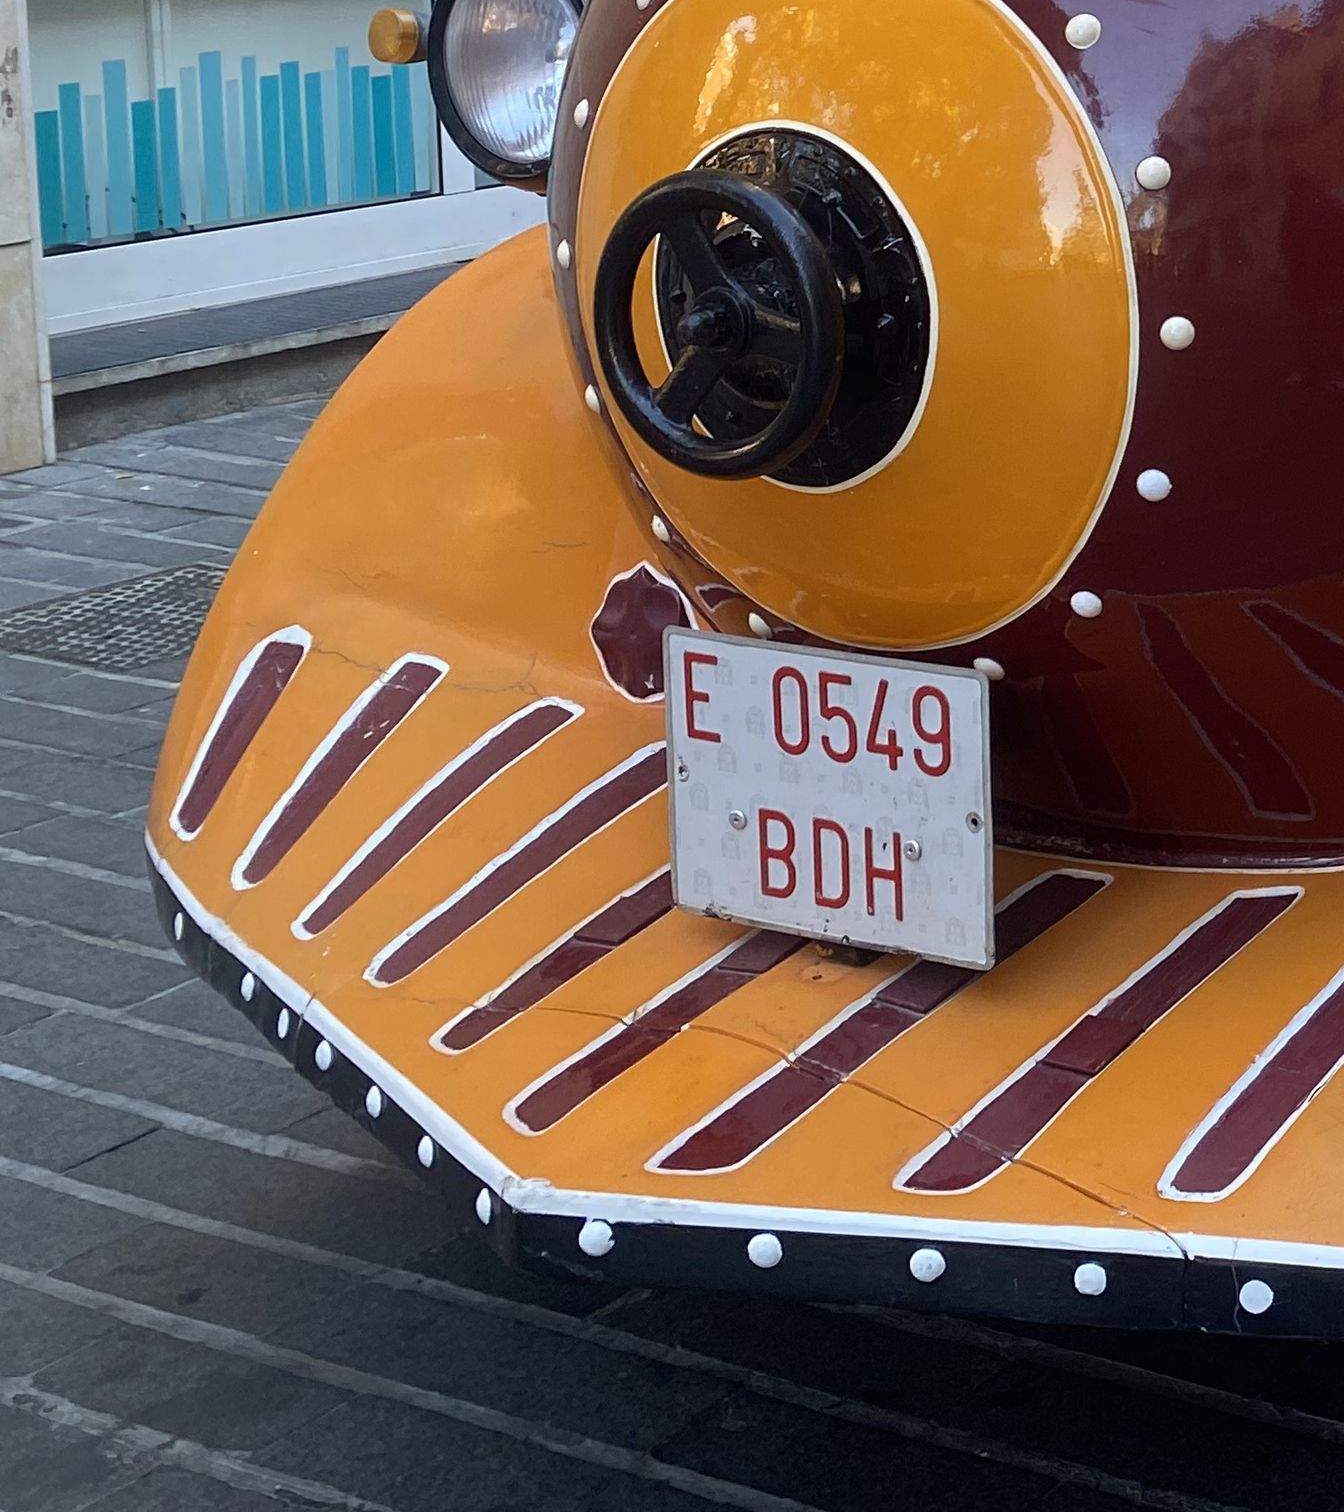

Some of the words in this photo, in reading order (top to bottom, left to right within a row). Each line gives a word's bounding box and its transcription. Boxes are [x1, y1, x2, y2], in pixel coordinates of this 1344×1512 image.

[684, 650, 721, 744] E
[772, 665, 952, 778] 0549
[758, 807, 904, 922] BDH
